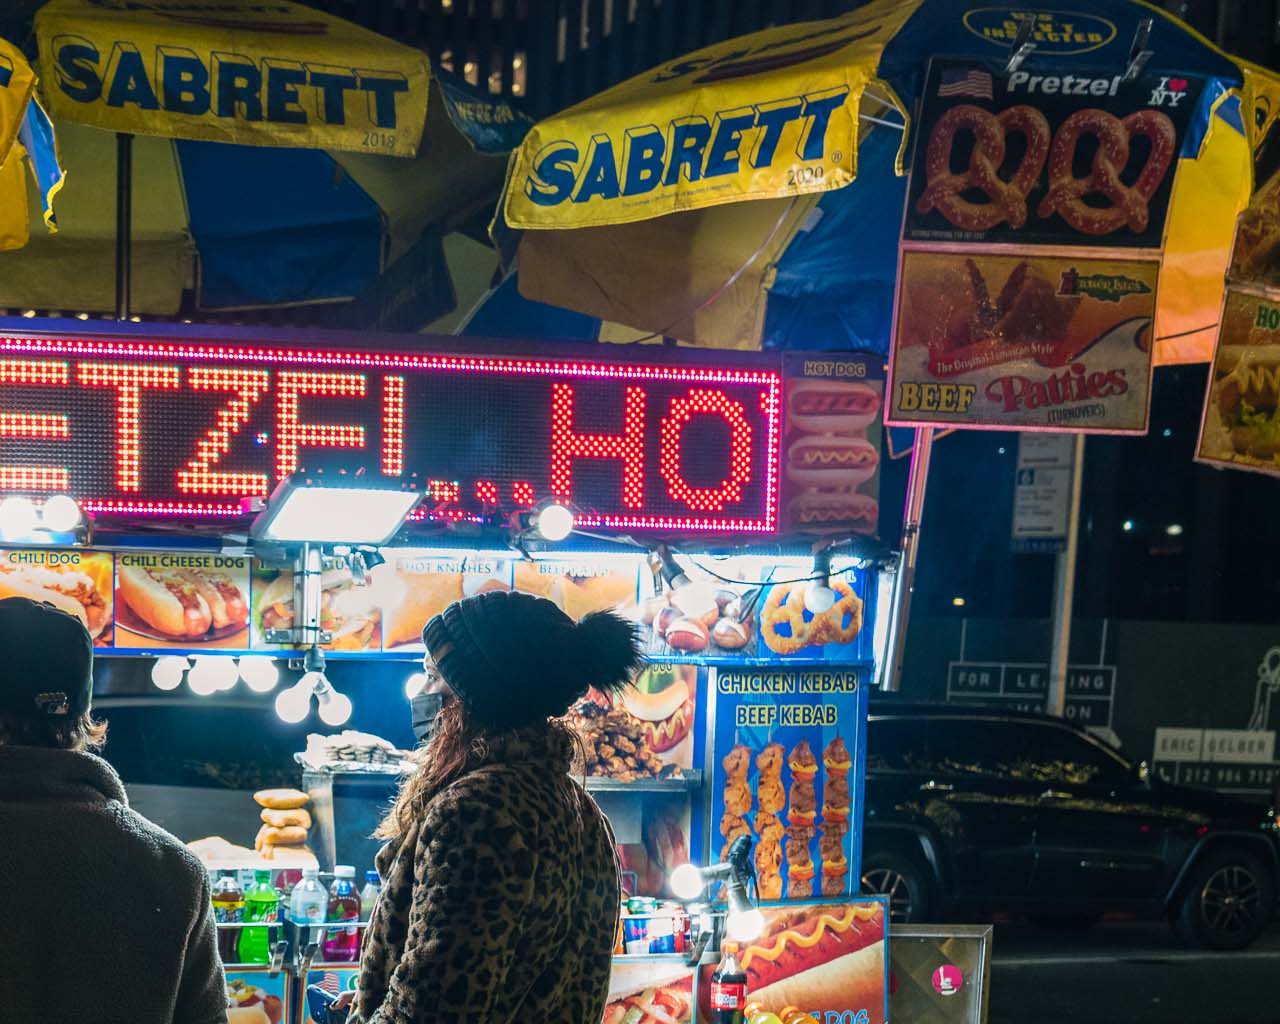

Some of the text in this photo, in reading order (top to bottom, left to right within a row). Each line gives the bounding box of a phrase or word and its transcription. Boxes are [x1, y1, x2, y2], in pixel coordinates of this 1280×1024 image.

[52, 34, 410, 129] SABRETT
[1006, 71, 1121, 97] Pretzel
[1159, 77, 1168, 91] I
[1147, 90, 1185, 106] NY
[361, 131, 395, 148] 2018
[524, 84, 851, 206] SABRETT
[787, 165, 824, 186] 2020
[1256, 305, 1280, 329] HO
[804, 361, 867, 378] HOT DOG
[899, 382, 976, 413] BEEF
[984, 362, 1128, 413] Patties
[1047, 403, 1105, 423] (TURNOVERS)
[8, 552, 81, 566] CHILI DOG
[121, 555, 158, 568] CHILI
[160, 556, 213, 569] CHEESE
[214, 557, 245, 570] DOG
[437, 564, 491, 575] KNISHES
[717, 673, 857, 694] CHICKEN KEBAB
[958, 672, 1104, 689] FOR LEING
[736, 705, 837, 727] BEEF KEBAB
